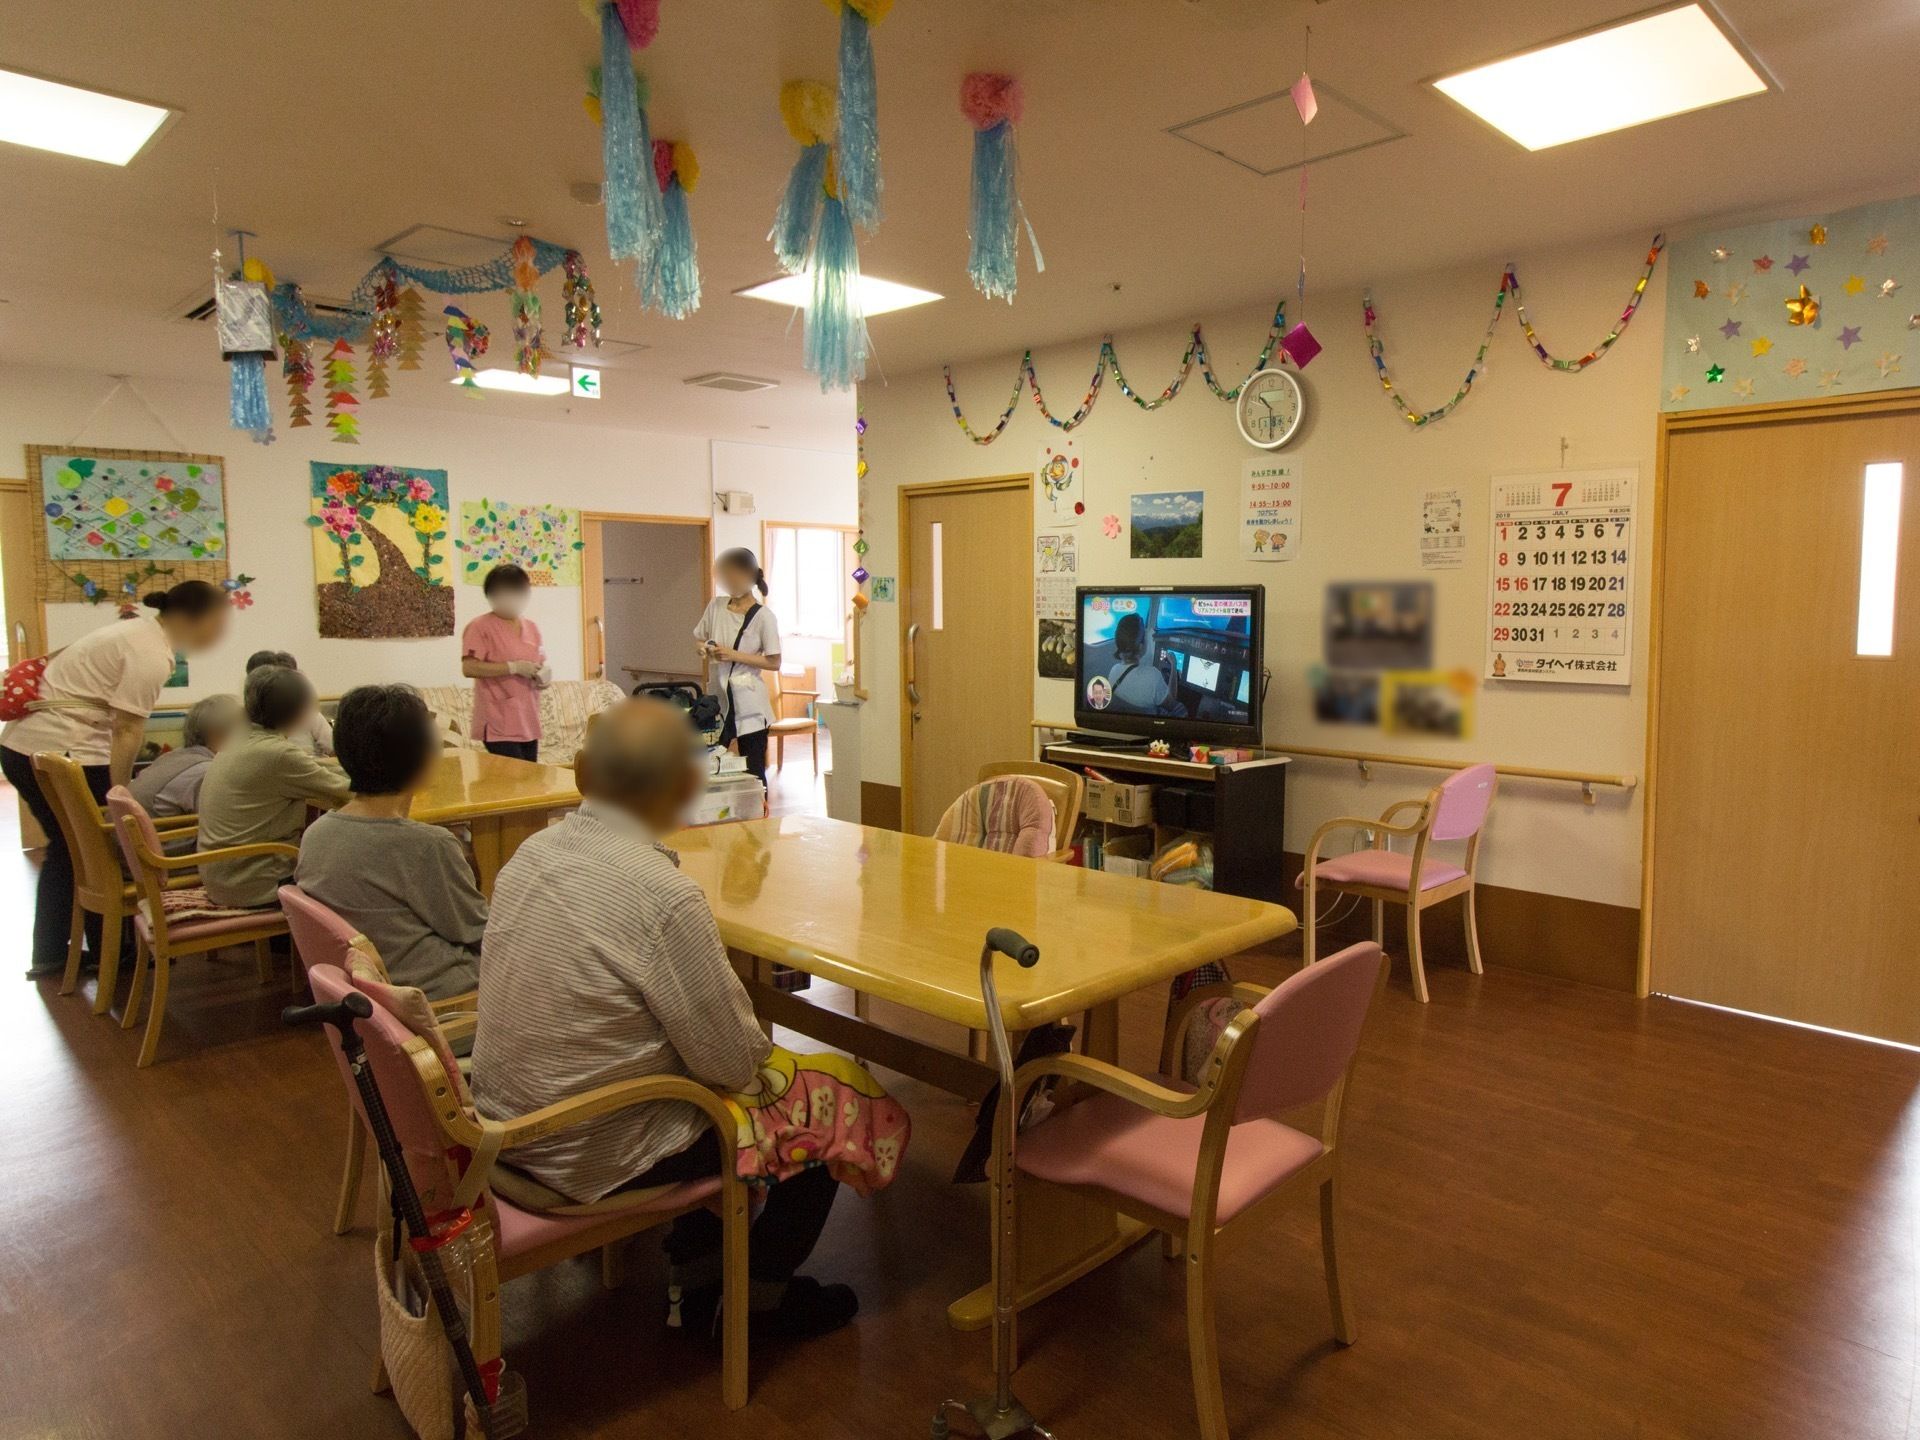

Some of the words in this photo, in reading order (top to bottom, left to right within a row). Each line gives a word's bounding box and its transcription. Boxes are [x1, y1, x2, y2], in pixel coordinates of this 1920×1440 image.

[1268, 379, 1275, 387] 12
[1248, 408, 1252, 416] 9
[1291, 403, 1295, 411] 3
[1251, 420, 1256, 428] 8
[1552, 483, 1572, 507] 7
[1500, 527, 1506, 541] 1
[1518, 527, 1528, 540] 2
[1536, 526, 1546, 540] 3
[1555, 525, 1565, 538] 4
[1574, 525, 1584, 538] 5
[1594, 524, 1604, 537] 6
[1615, 523, 1624, 537] 7
[1498, 553, 1507, 566] 8
[1517, 553, 1526, 565] 9
[1533, 552, 1548, 565] 10
[1552, 552, 1565, 565] 11
[1571, 551, 1587, 565] 12
[1591, 551, 1606, 564] 13
[1611, 550, 1626, 564] 14
[1496, 577, 1510, 591] 15
[1514, 577, 1528, 590] 16
[1533, 577, 1547, 590] 17
[1551, 577, 1566, 590] 18
[1571, 577, 1585, 590] 19
[1589, 577, 1606, 590] 20
[1608, 577, 1624, 590] 21
[1494, 603, 1510, 616] 22
[1512, 603, 1528, 616] 23
[1531, 603, 1546, 616] 24
[1549, 603, 1566, 617] 25
[1568, 603, 1585, 617] 26
[1588, 603, 1605, 617] 27
[1608, 604, 1625, 617] 28
[1494, 628, 1509, 641] 29
[1511, 628, 1527, 641] 30
[1530, 629, 1544, 641] 31
[1554, 629, 1558, 638] 1
[1572, 629, 1579, 639] 2
[1592, 630, 1598, 639] 3
[1612, 630, 1619, 639] 4
[1536, 658, 1617, 672] タイヘイ株式会社
